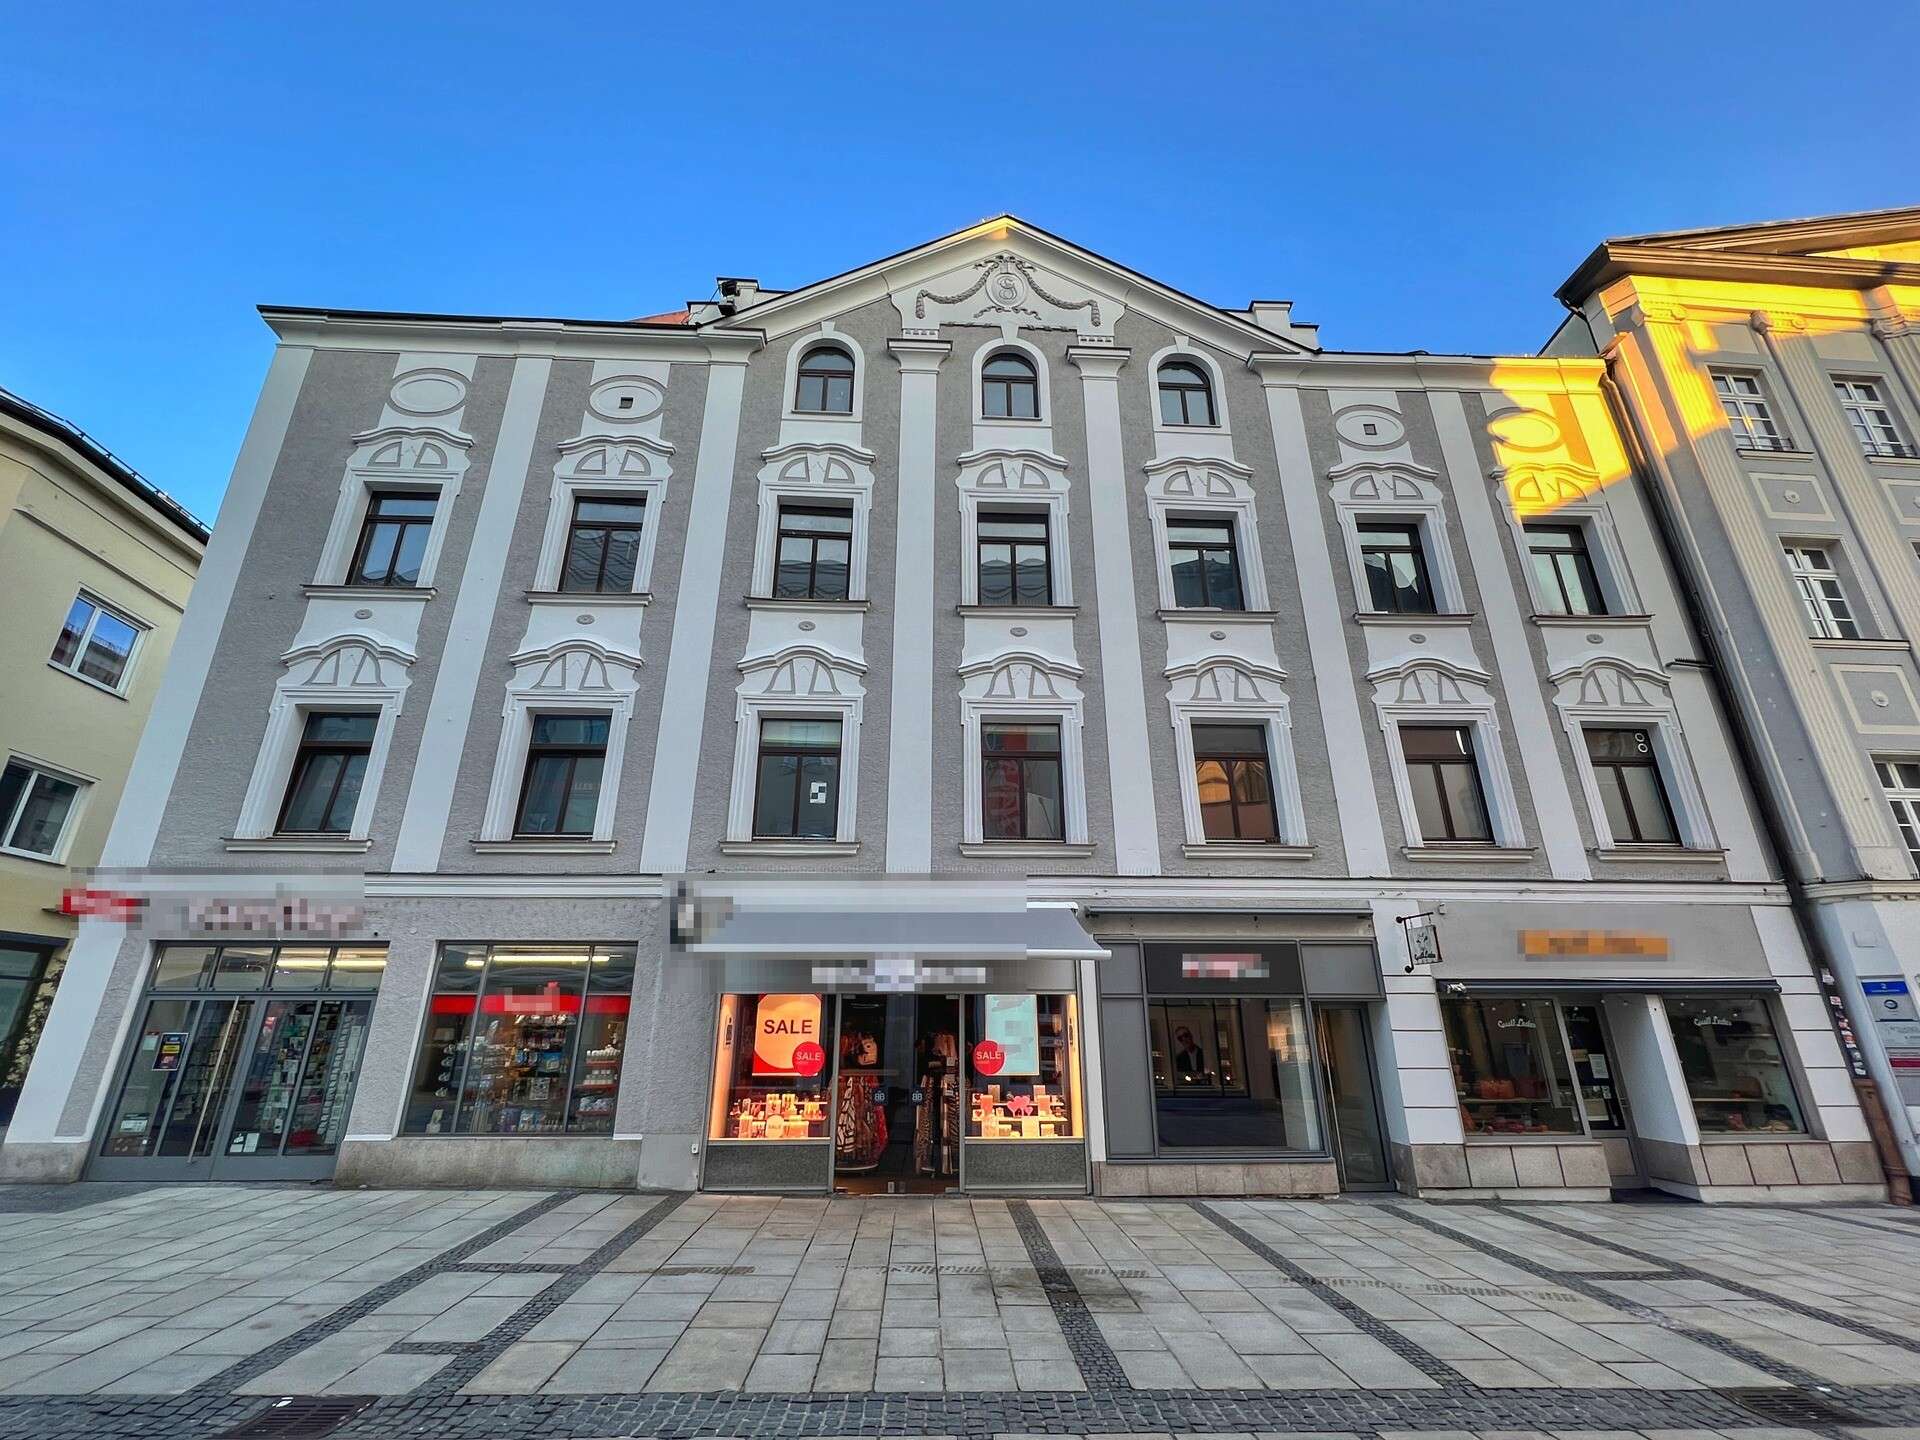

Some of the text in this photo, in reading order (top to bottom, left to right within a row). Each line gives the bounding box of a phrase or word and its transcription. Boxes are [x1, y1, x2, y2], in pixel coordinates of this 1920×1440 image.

[763, 1019, 813, 1035] SALE
[796, 1051, 821, 1061] SALE
[975, 1051, 1002, 1061] SALE
